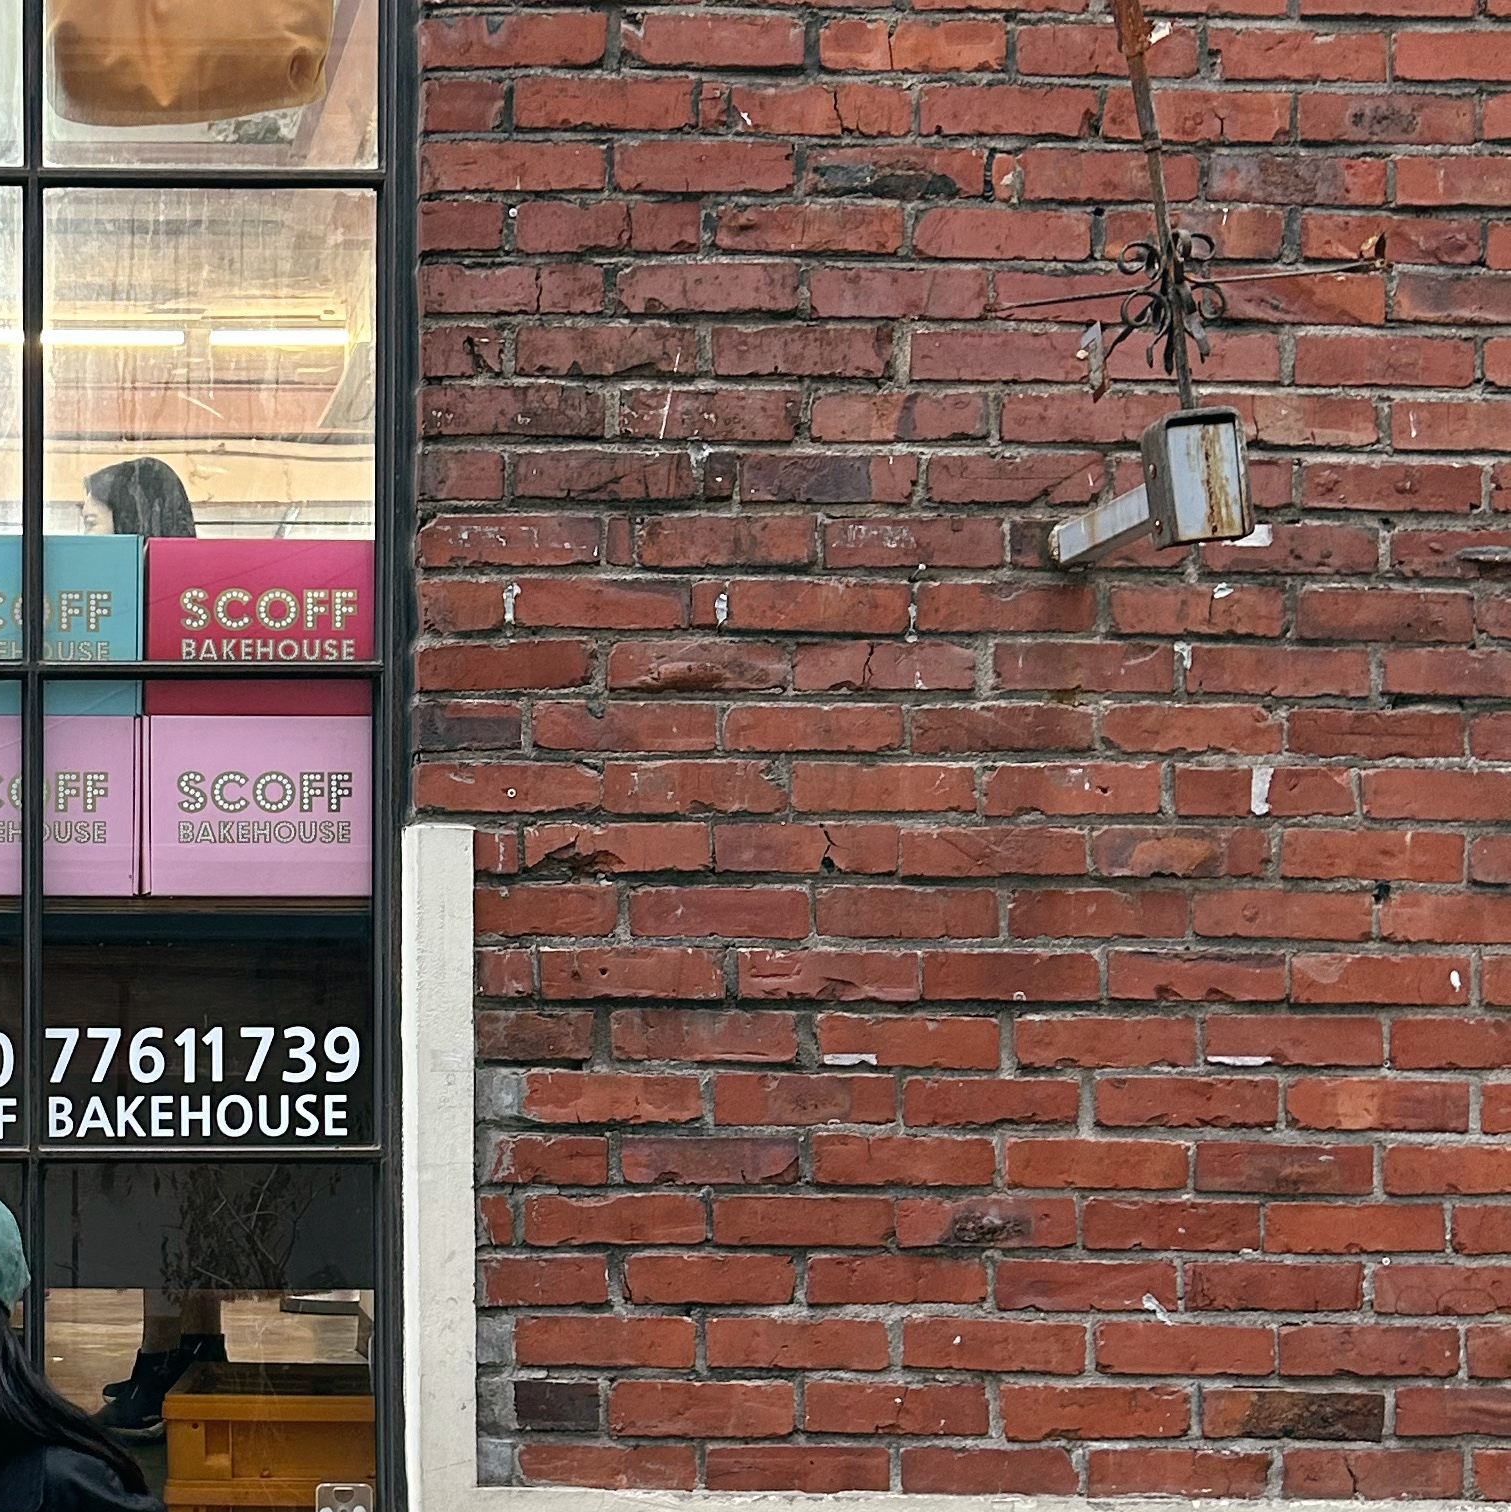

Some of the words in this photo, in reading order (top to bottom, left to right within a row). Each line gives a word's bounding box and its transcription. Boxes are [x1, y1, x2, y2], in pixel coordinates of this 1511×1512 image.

[180, 588, 358, 631] SCOFF
[181, 638, 356, 661] BAKEHOUSE
[177, 770, 353, 813] SCOFF
[178, 820, 352, 843] BAKEHOUSE
[44, 1026, 361, 1083] 77611739
[48, 1094, 349, 1138] BAKEHOUSE
